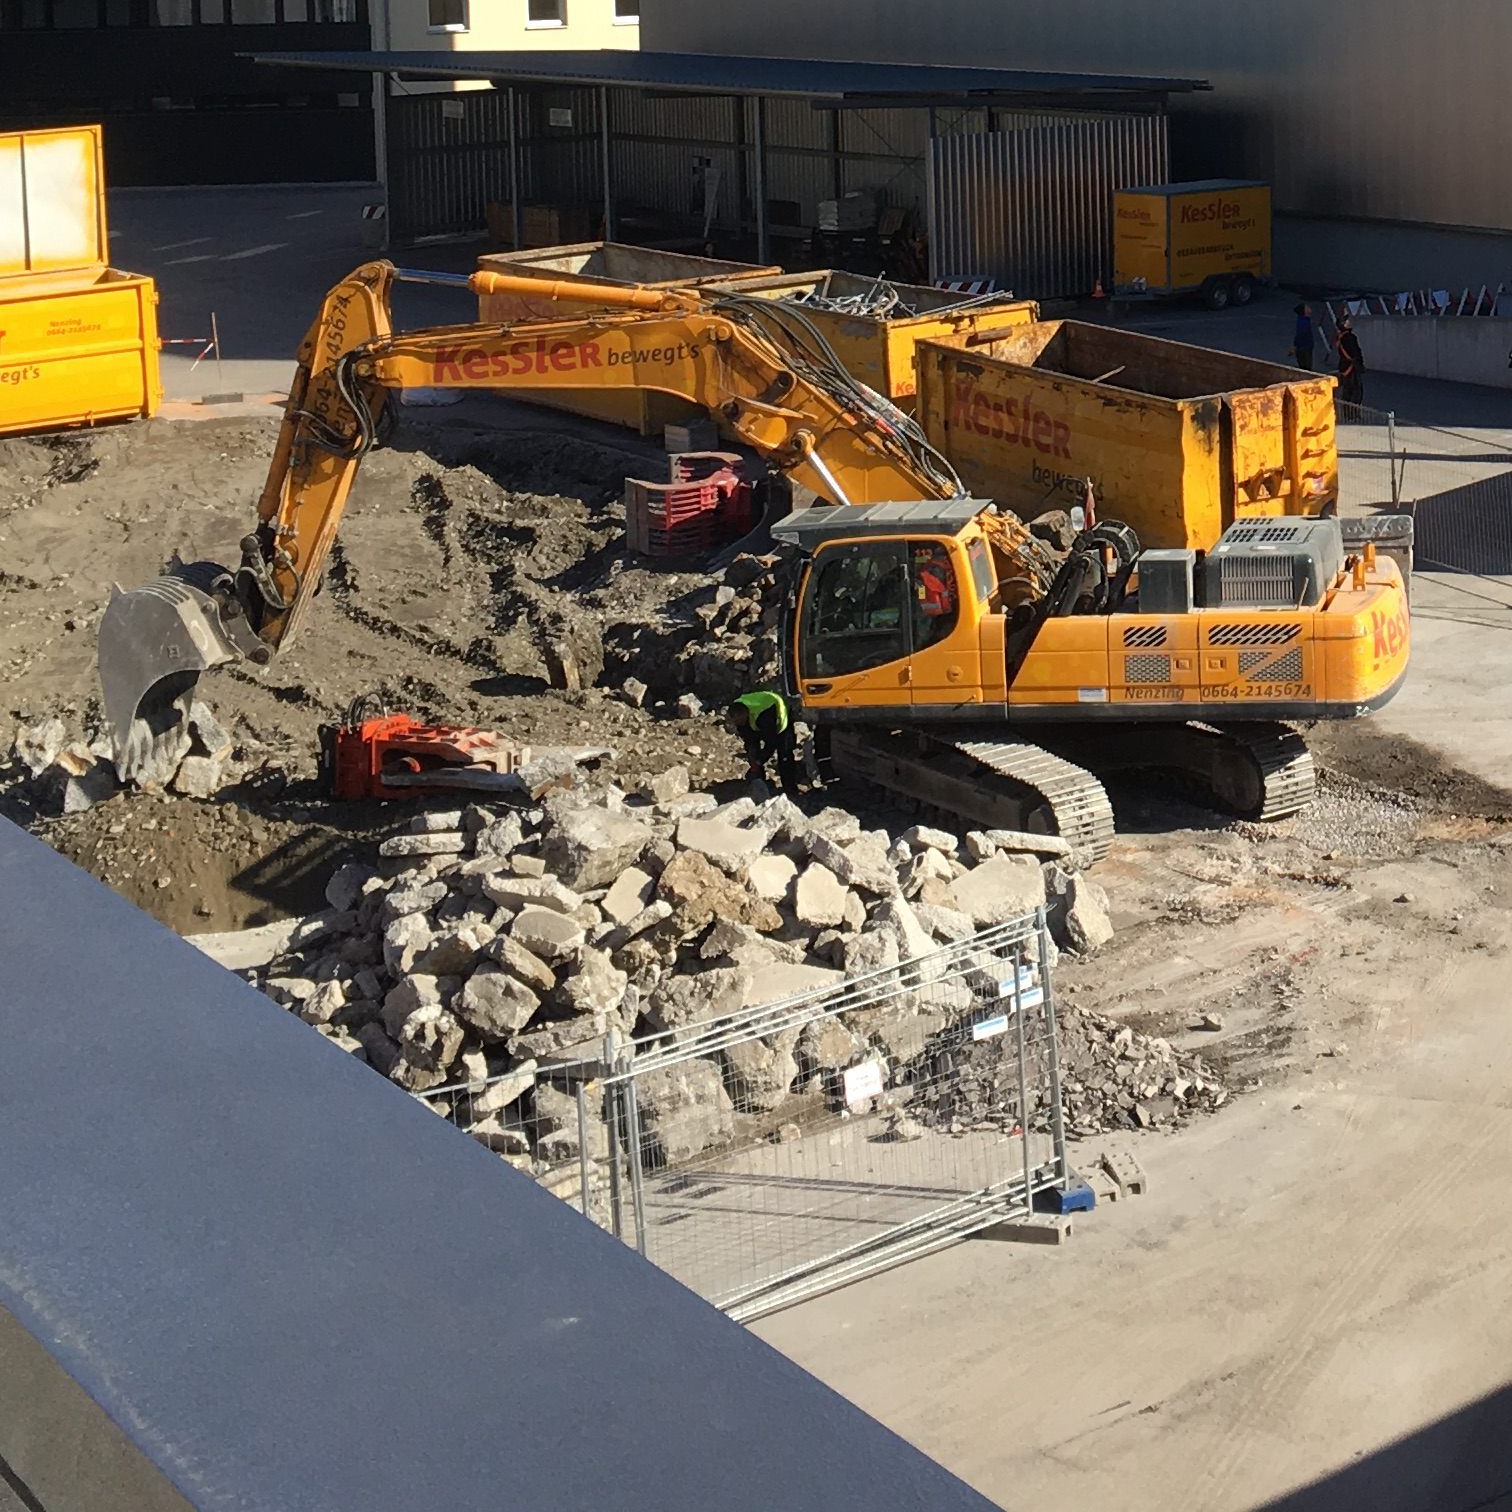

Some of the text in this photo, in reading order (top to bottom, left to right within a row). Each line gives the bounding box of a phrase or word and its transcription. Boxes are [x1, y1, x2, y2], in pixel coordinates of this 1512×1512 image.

[608, 342, 700, 366] bewegt's
[1124, 683, 1312, 701] Nenzing 0664-2145674
